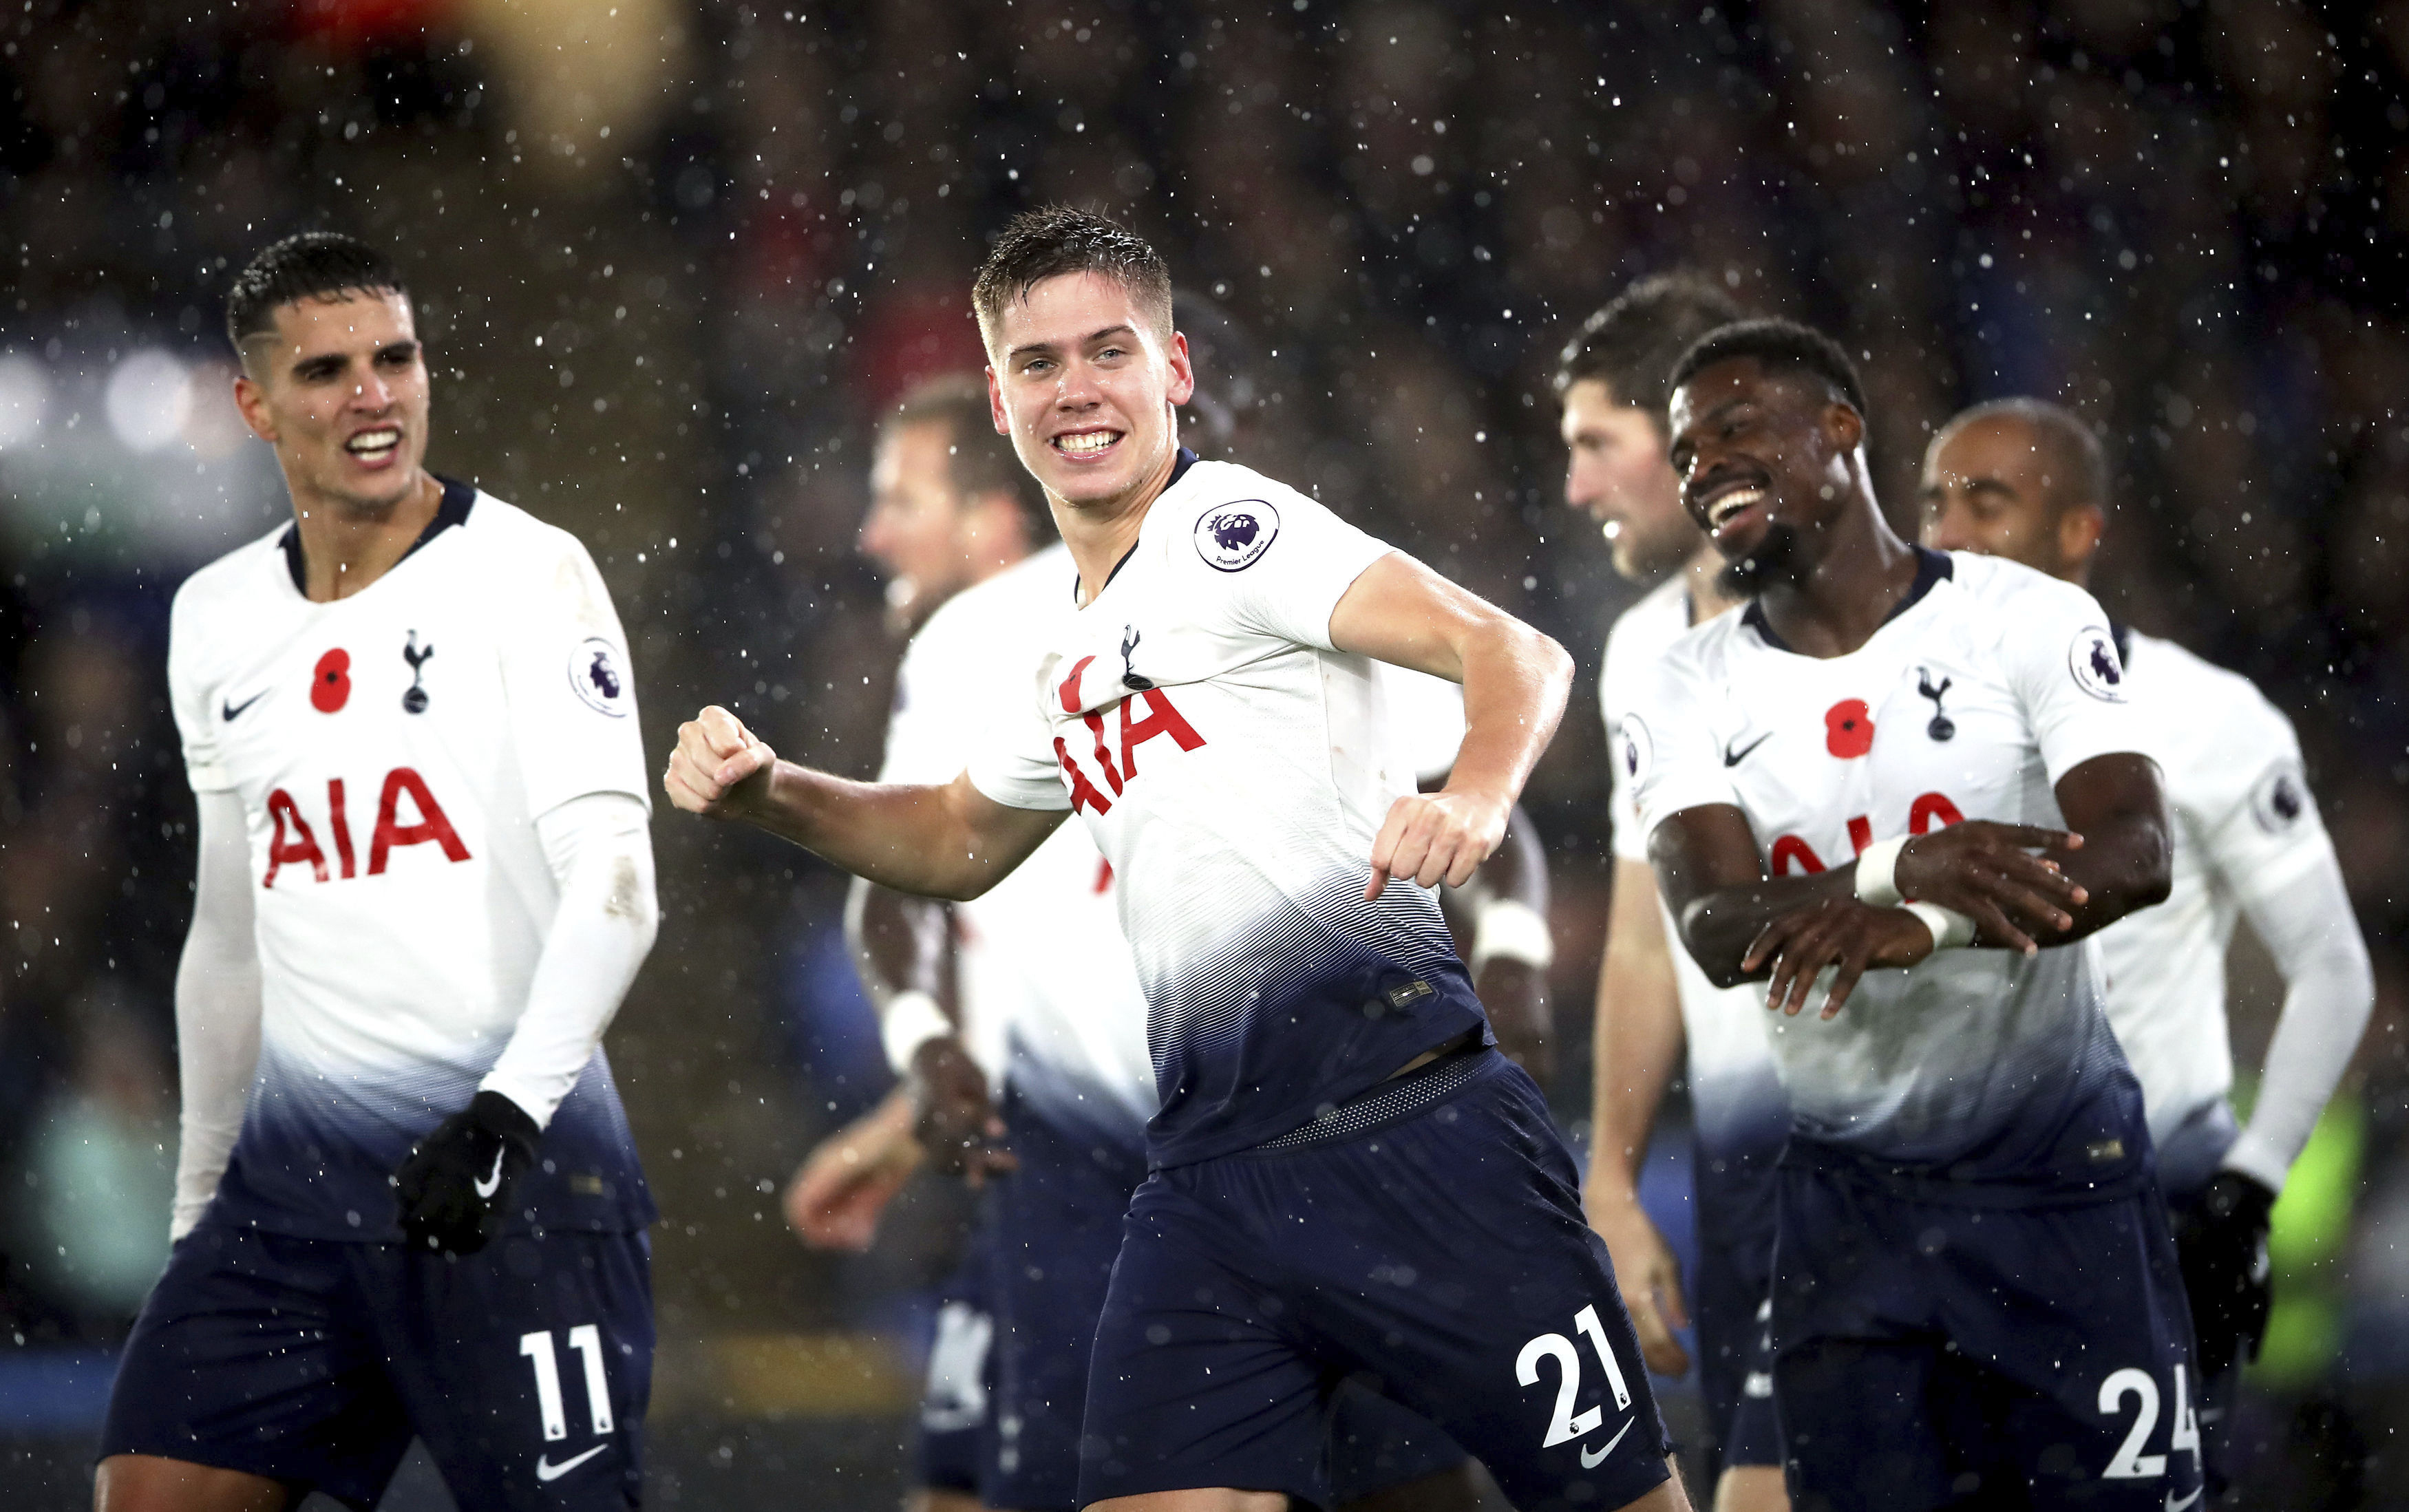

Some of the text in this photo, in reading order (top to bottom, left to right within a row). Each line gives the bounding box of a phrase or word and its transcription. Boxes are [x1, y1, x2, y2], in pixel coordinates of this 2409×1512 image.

[1216, 540, 1264, 565] Premier League
[1053, 687, 1207, 816] AIA
[263, 765, 472, 889] AIA
[520, 1323, 615, 1442] 11
[1516, 1303, 1632, 1449] 21
[2098, 1363, 2203, 1480] 24
